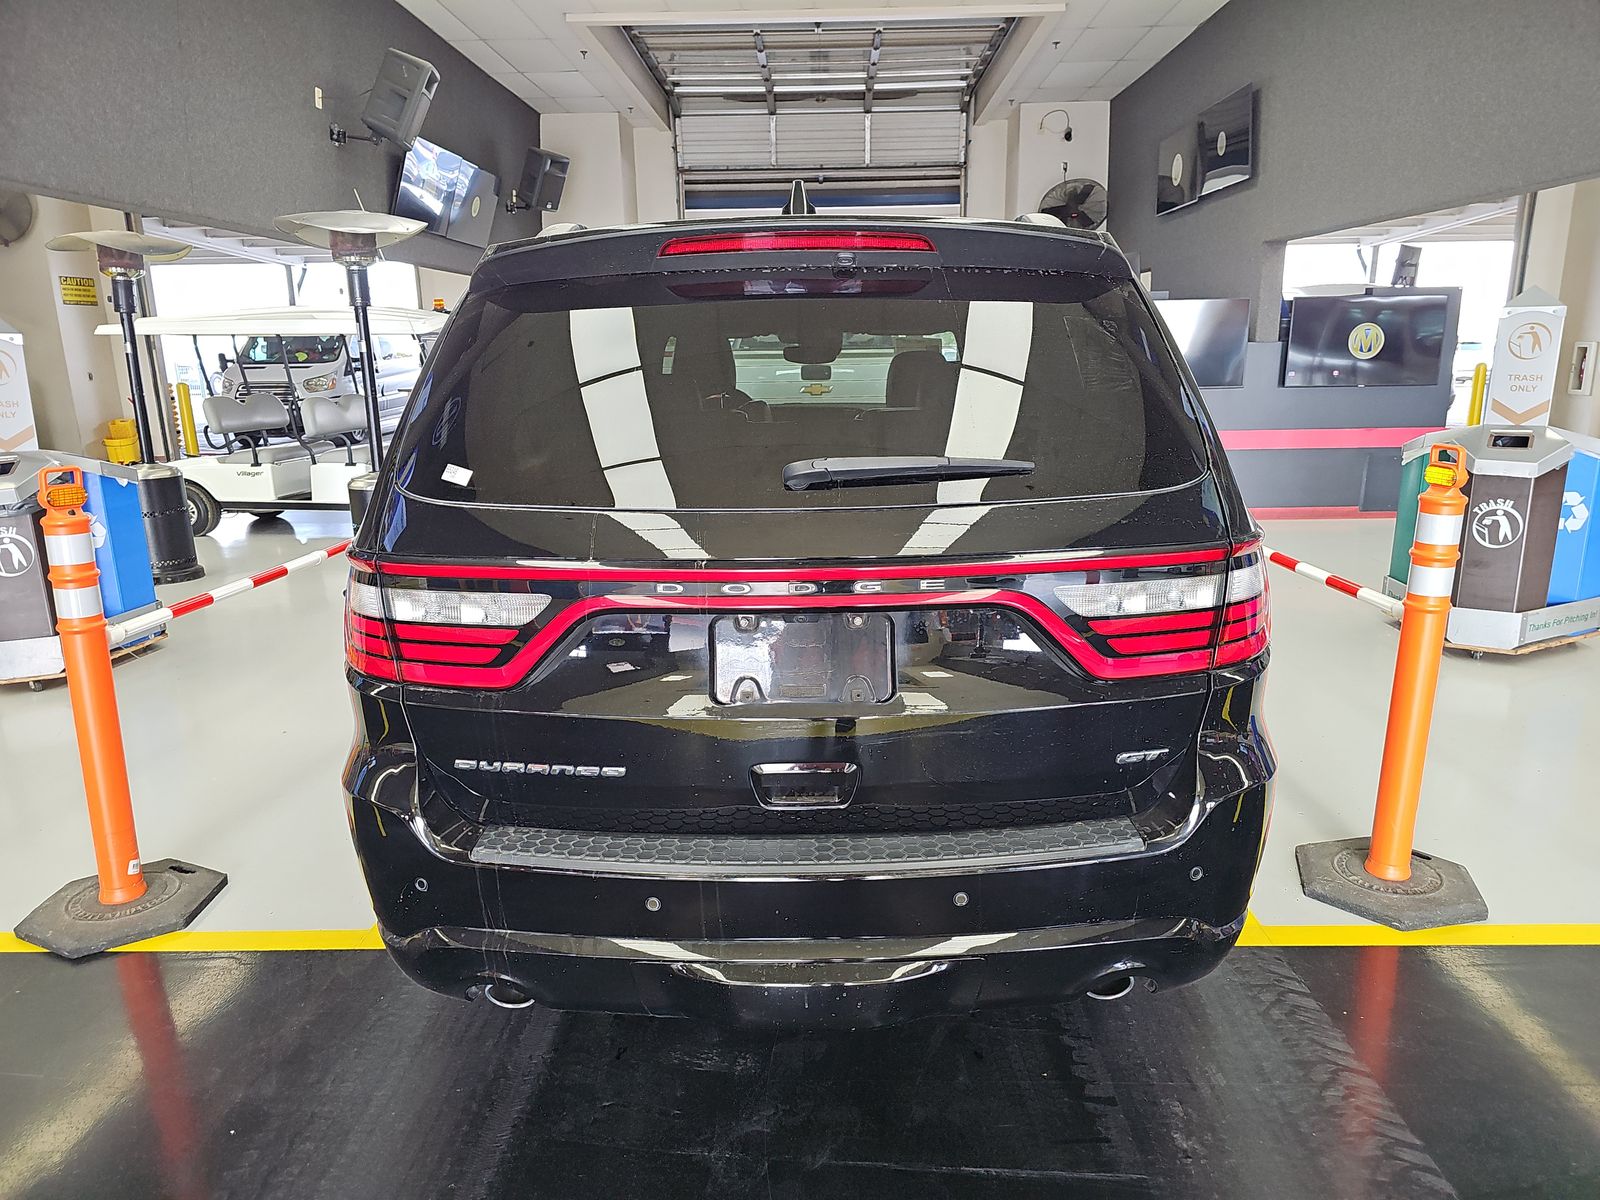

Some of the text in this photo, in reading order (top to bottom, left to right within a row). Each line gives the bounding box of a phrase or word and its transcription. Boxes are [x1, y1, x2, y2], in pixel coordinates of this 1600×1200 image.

[60, 276, 95, 287] CAUTION
[1508, 374, 1543, 382] TRASH
[1510, 384, 1538, 392] ONLY
[1473, 498, 1515, 514] TRASH
[656, 579, 946, 595] DODGE
[1529, 620, 1551, 632] Thanks
[1552, 618, 1564, 627] For
[1564, 613, 1589, 625] Pitching
[1115, 748, 1170, 765] GT
[454, 759, 627, 778] DURANGO
